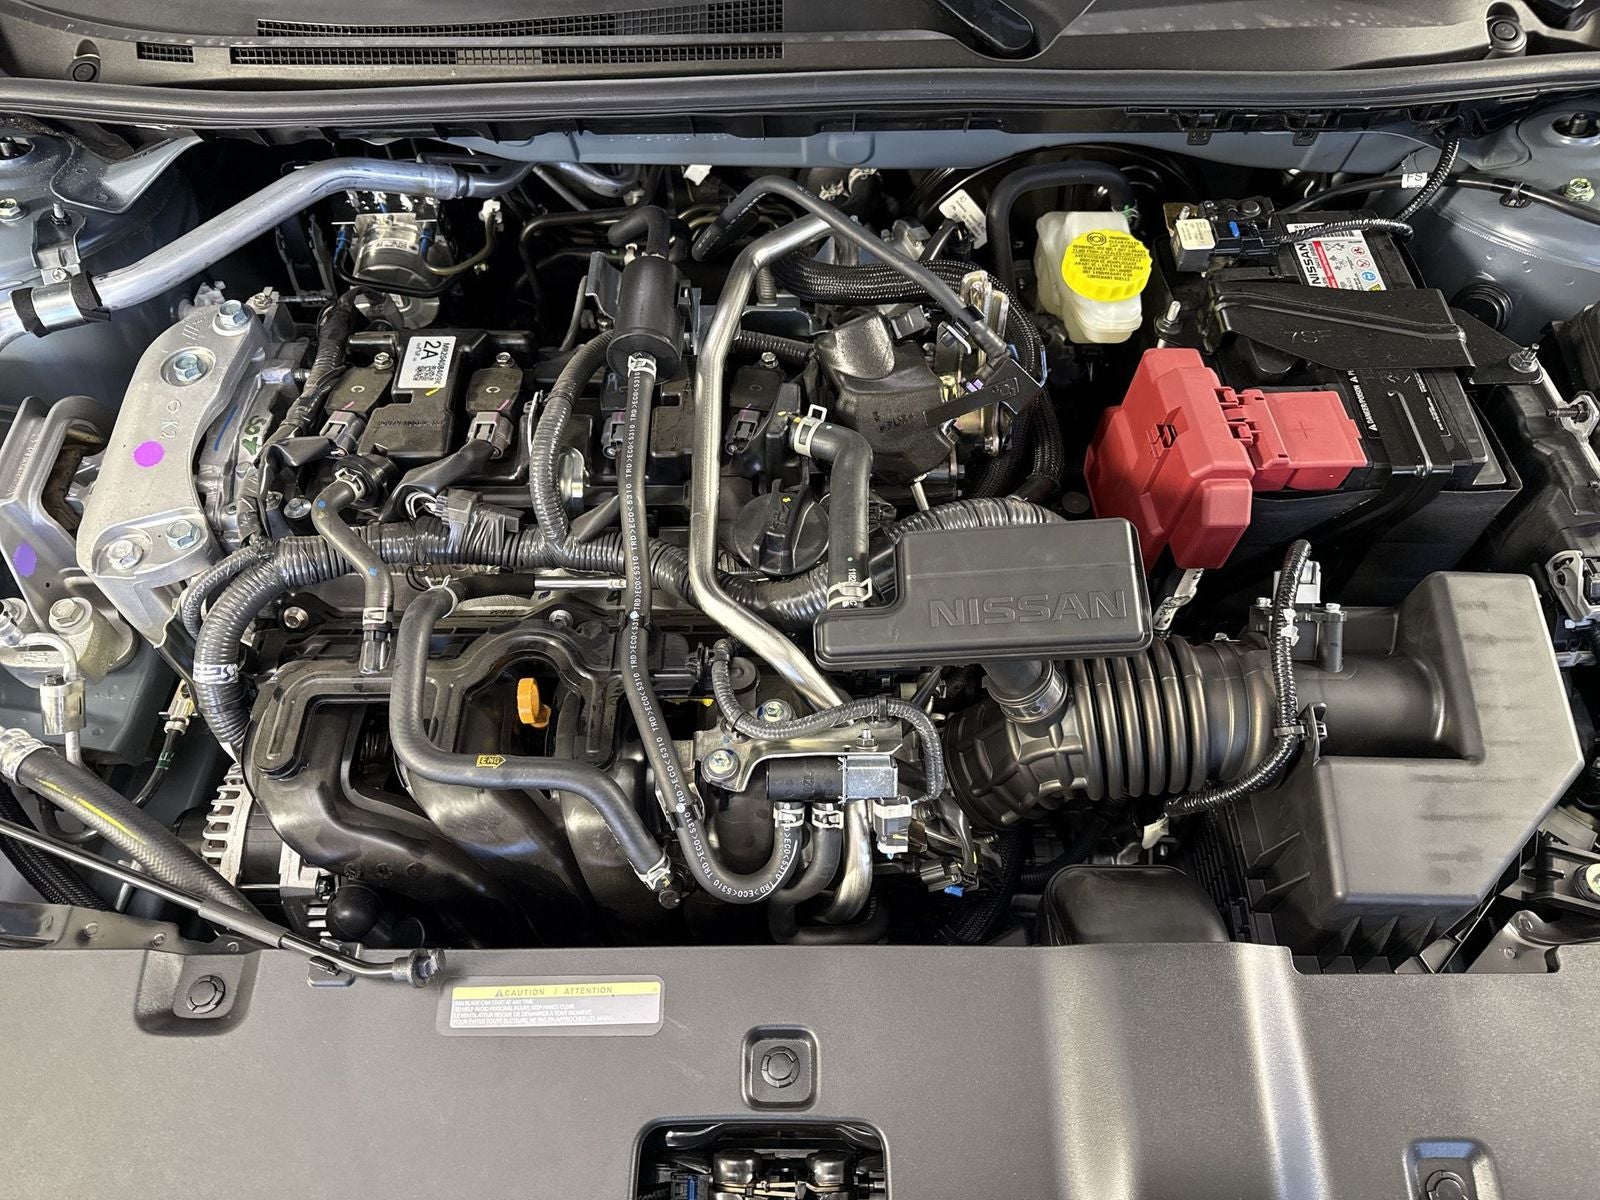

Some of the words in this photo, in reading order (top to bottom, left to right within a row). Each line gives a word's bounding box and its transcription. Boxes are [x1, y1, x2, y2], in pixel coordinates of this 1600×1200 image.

[1297, 243, 1321, 285] NISSAN
[421, 340, 442, 360] 2A
[624, 424, 636, 478] TRD>ECO<5310
[626, 483, 637, 551] TRD>ECO<5310
[929, 590, 1127, 628] NISSAN
[629, 616, 640, 669] TRD>ECO<531
[632, 673, 659, 732] TRD>ECO<5310
[564, 987, 613, 995] ATTENTION
